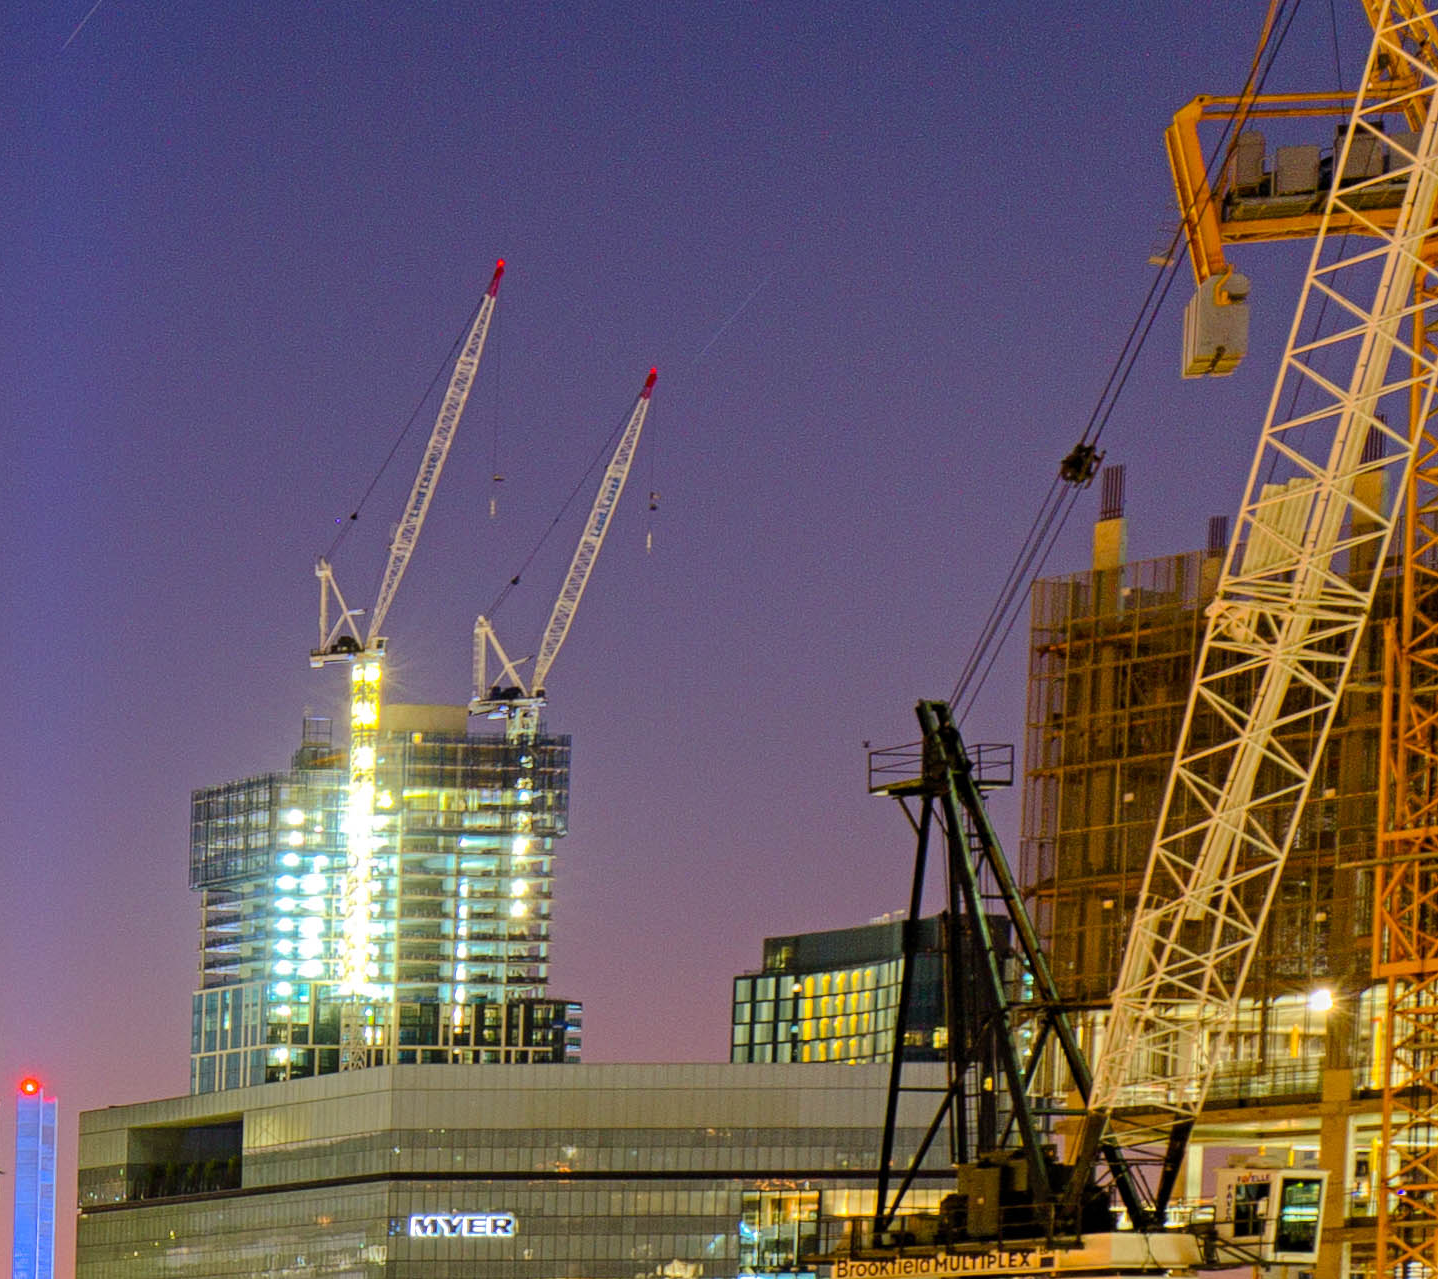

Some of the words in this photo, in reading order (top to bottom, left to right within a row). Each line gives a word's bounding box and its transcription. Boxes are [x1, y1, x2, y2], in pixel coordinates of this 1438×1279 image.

[411, 1215, 515, 1237] MYER
[836, 1257, 931, 1278] Brookfield
[935, 1251, 1030, 1272] MULTIPLEX
